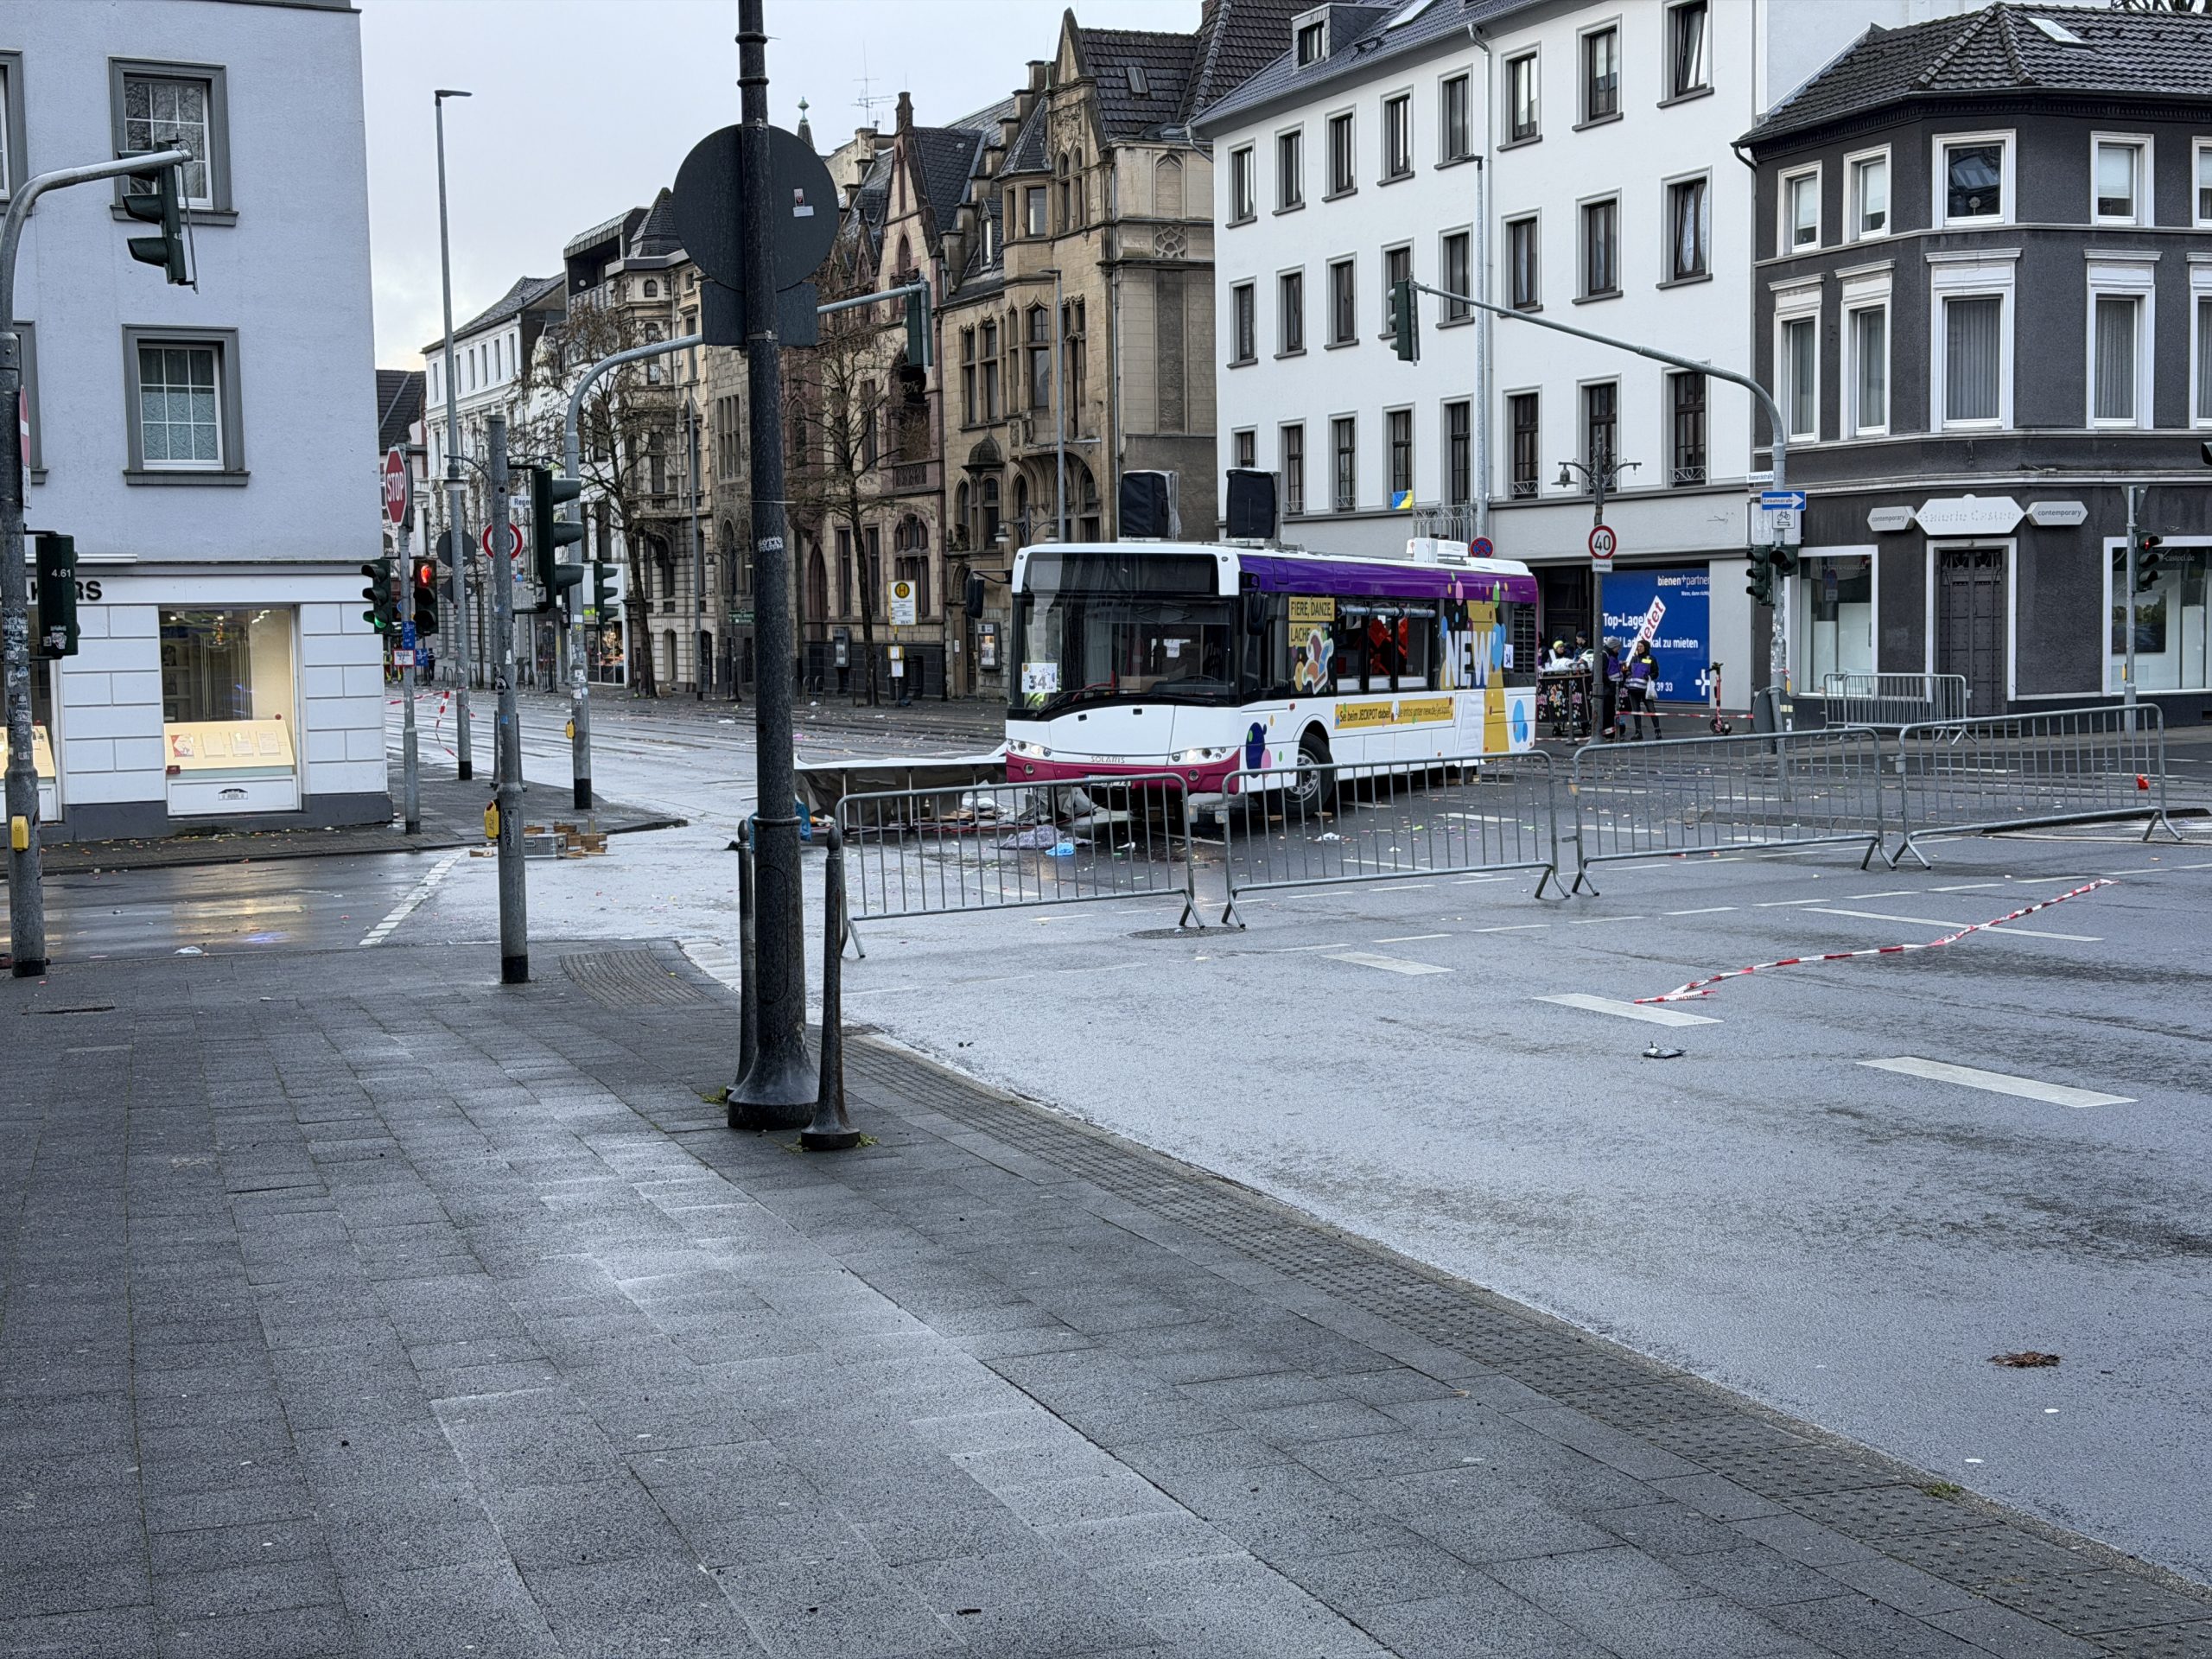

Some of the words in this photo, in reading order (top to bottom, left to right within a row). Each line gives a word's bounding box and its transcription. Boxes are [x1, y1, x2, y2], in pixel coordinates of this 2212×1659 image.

[387, 473, 404, 501] STOP
[2037, 509, 2082, 518] contemporary
[1594, 535, 1611, 551] 40
[51, 569, 71, 578] 4.61
[1291, 601, 1310, 619] FIERE,
[1311, 601, 1332, 619] DANZE,
[1662, 639, 1671, 648] zu
[1673, 637, 1698, 648] mieten
[1029, 675, 1046, 690] 34
[1656, 682, 1664, 692] 39
[1665, 682, 1673, 692] 33
[1347, 710, 1358, 722] beim
[1358, 708, 1378, 721] JECKPOT
[1090, 755, 1125, 764] SOLARIS
